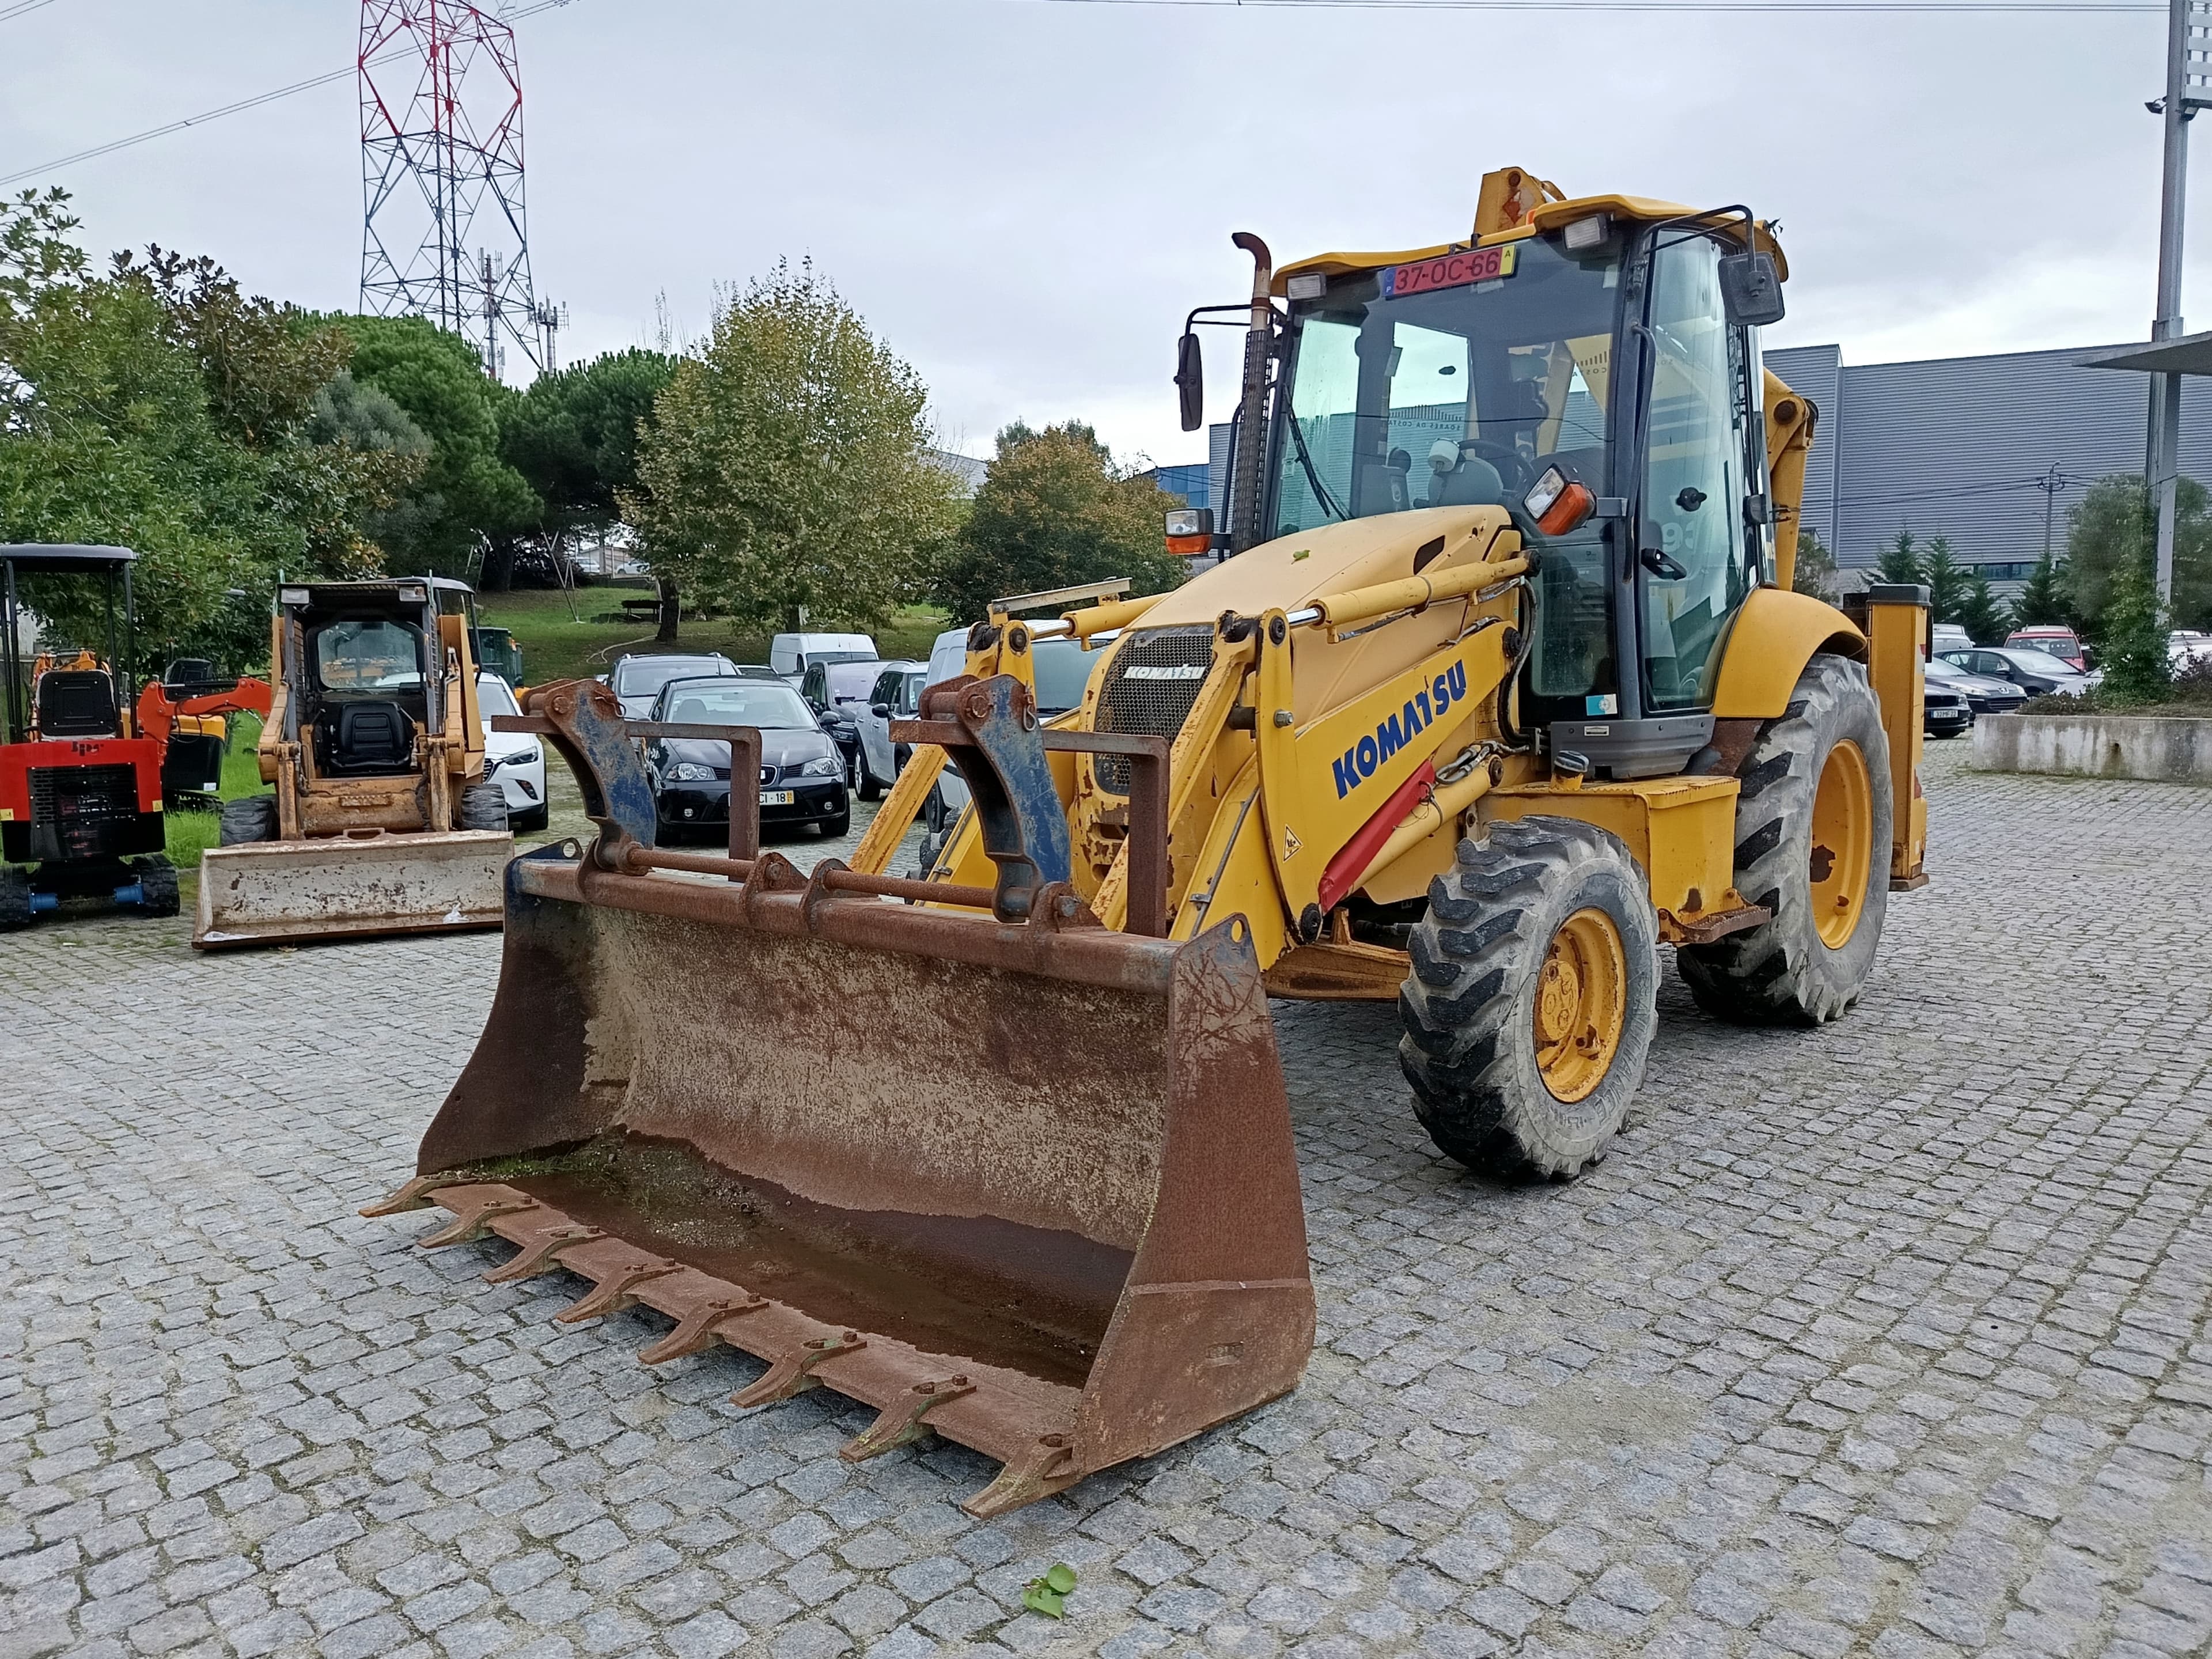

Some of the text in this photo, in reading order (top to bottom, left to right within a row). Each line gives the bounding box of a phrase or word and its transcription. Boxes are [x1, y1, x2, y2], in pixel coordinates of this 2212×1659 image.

[1396, 252, 1499, 290] 37-OC-66
[1124, 664, 1207, 680] KOMATSU
[1332, 658, 1467, 800] KOMATSU
[1593, 995, 1649, 1126] ALLIANCE
